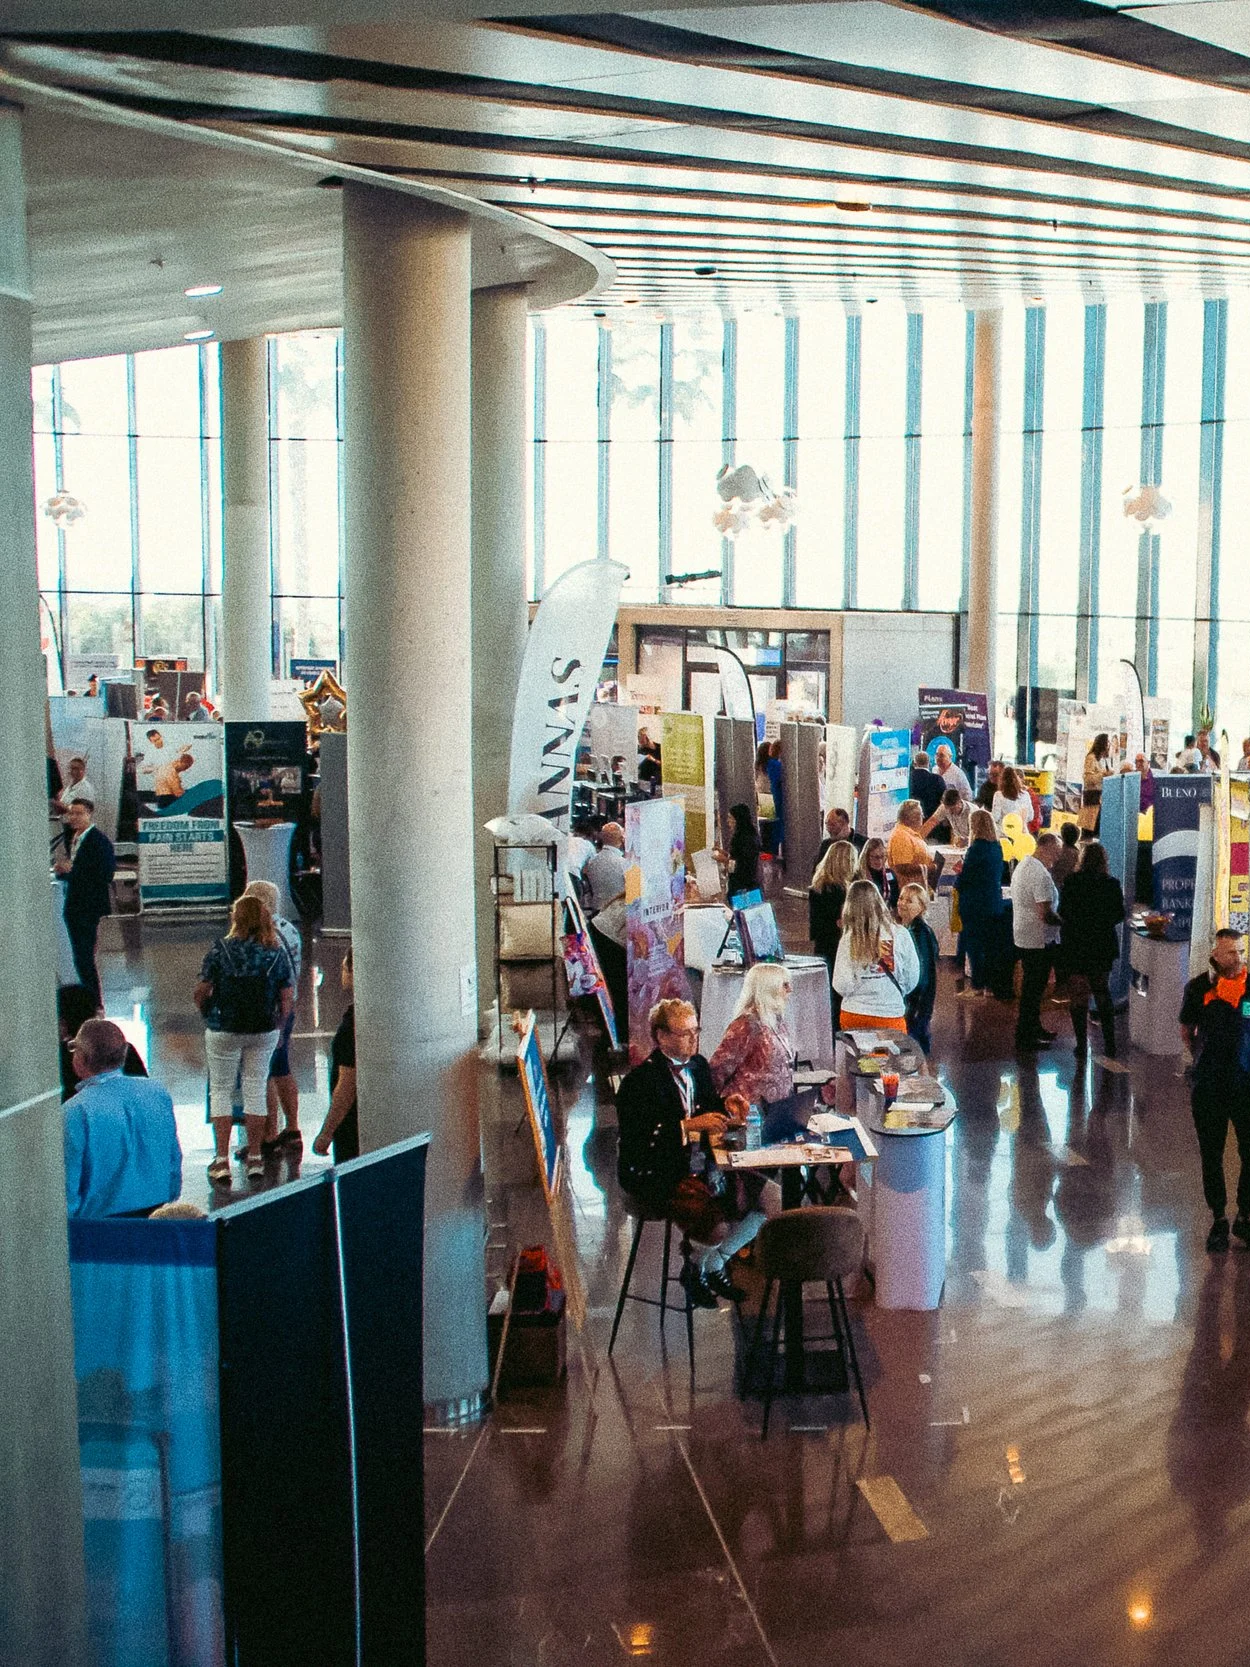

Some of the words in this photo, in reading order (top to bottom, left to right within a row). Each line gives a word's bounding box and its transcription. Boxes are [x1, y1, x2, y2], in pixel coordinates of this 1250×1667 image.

[535, 655, 583, 836] ANNA'S
[1161, 787, 1197, 798] BUENO
[142, 820, 190, 831] FREEDOM
[192, 820, 220, 830] FROM
[148, 832, 174, 843] PAIN
[175, 831, 215, 842] STARTS
[642, 902, 670, 917] INTERIOR
[1161, 899, 1194, 909] BANK
